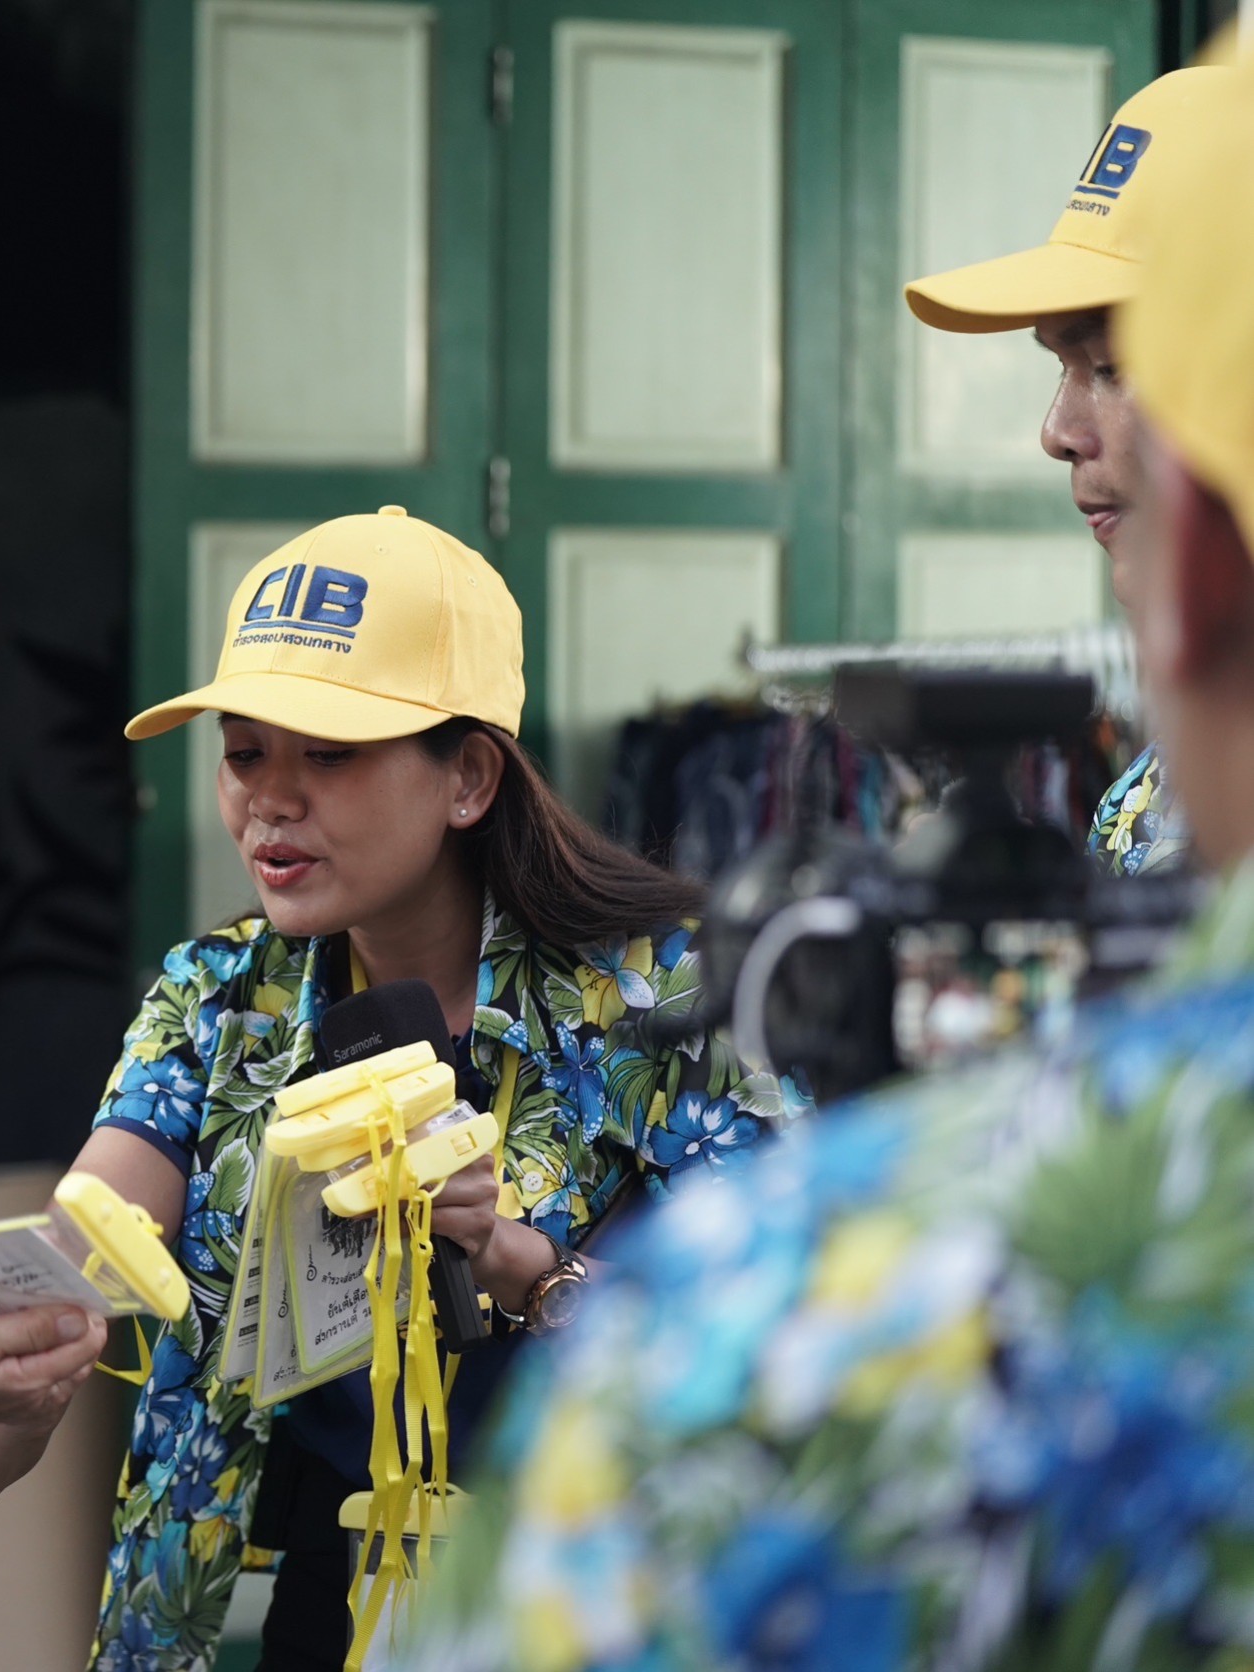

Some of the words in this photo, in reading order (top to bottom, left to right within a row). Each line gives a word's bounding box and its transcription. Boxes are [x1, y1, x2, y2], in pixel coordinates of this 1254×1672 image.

[1080, 123, 1152, 188] IB
[245, 563, 368, 628] CIB
[333, 1031, 383, 1063] Saramonic
